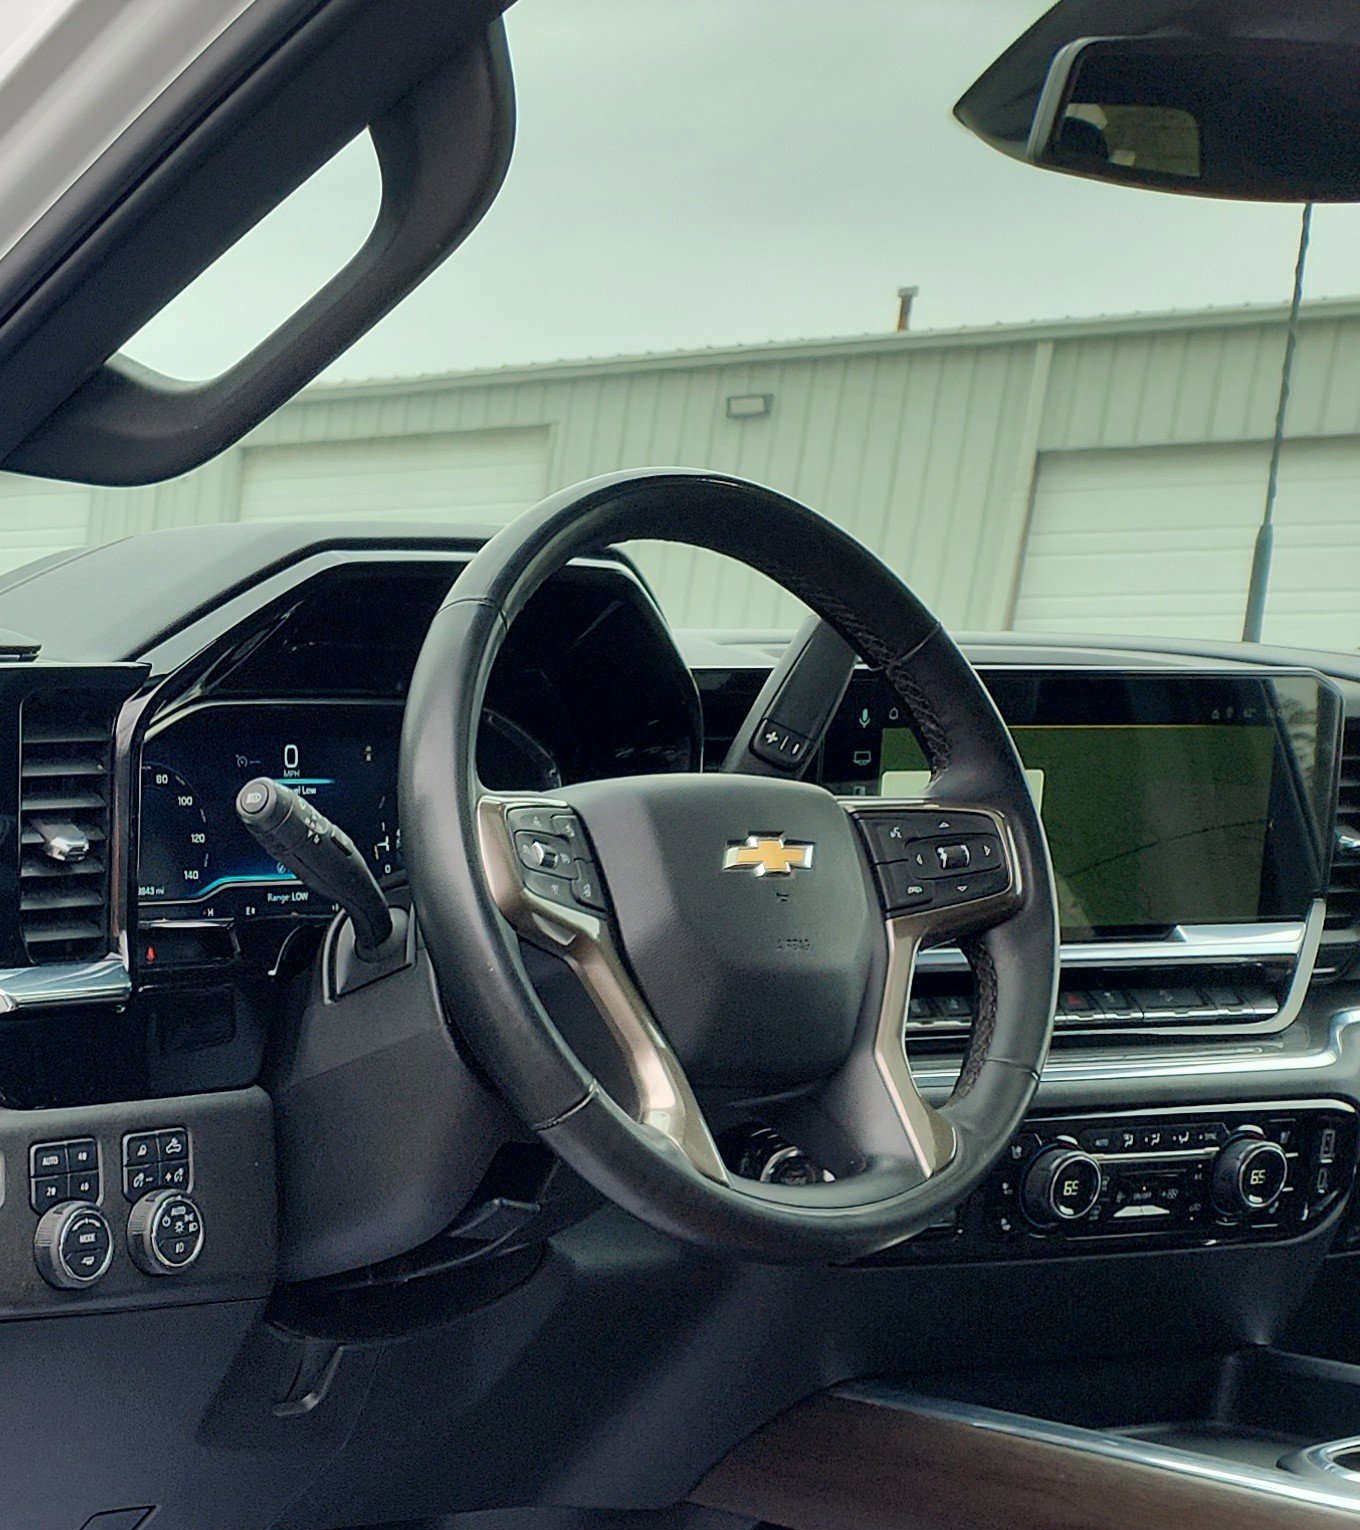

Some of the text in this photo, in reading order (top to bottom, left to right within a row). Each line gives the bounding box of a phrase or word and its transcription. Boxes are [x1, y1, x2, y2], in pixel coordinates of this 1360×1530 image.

[284, 744, 299, 769] 0
[283, 769, 300, 778] MPH
[155, 774, 169, 785] 80
[178, 795, 193, 806] 100
[191, 833, 205, 843] 120
[183, 869, 199, 880] 140
[267, 891, 308, 905] Range LOW
[42, 1155, 59, 1167] AUTO
[1250, 1169, 1266, 1185] 65
[1063, 1180, 1079, 1196] 65
